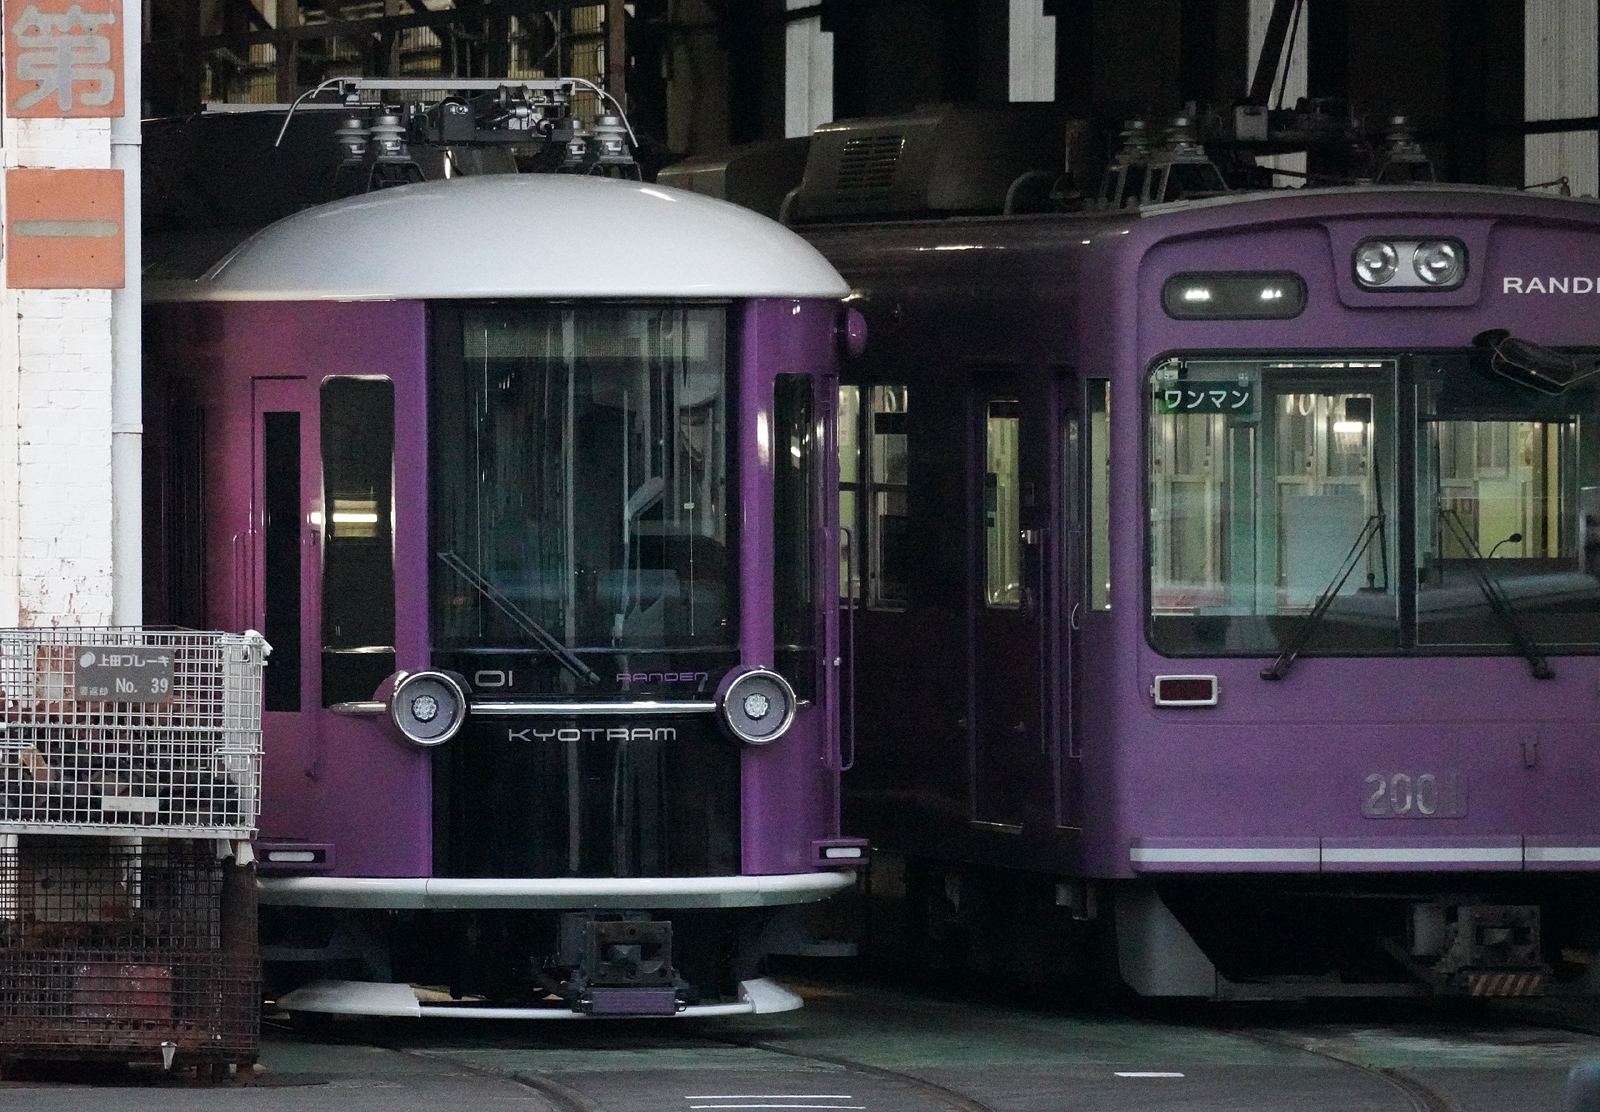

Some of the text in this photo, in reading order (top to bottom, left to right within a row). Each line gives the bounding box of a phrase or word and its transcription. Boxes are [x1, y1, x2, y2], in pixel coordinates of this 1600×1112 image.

[1503, 277, 1600, 294] RAND
[1165, 390, 1249, 409] ワンマン
[97, 654, 170, 668] 上田ブレーキ
[616, 672, 708, 683] RANDEN
[115, 678, 169, 694] No. 39
[508, 727, 677, 742] KYOTRAM
